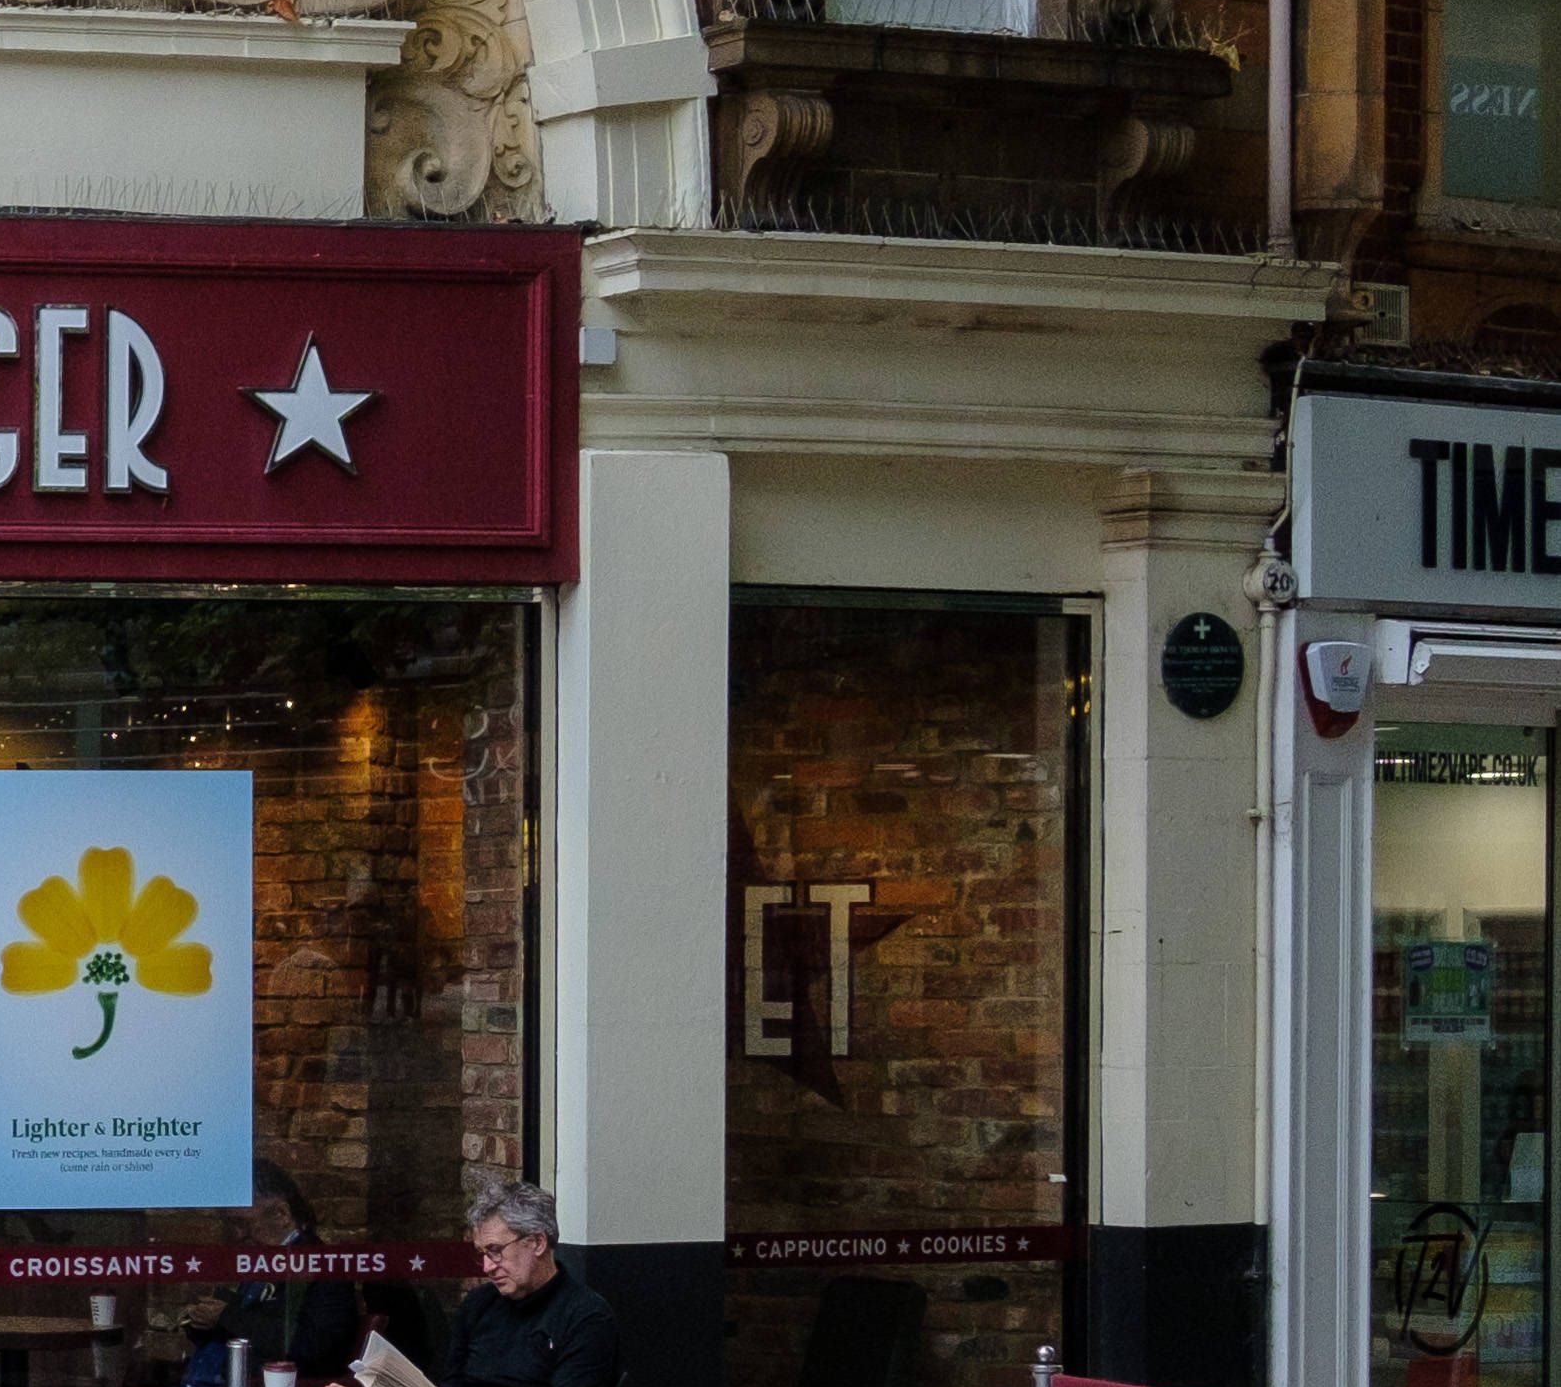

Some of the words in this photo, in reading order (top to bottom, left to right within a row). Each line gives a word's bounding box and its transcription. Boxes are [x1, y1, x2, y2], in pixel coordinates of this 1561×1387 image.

[12, 1117, 90, 1143] Lighter
[95, 1122, 106, 1136] &
[112, 1117, 202, 1142] Brighter
[12, 1149, 38, 1159] Fresh
[40, 1150, 59, 1158] new
[101, 1149, 153, 1158] handmade
[155, 1149, 180, 1159] every
[756, 1237, 887, 1259] CAPPUCCINO
[920, 1235, 1006, 1255] COOKIES
[9, 1255, 174, 1277] CROISSANTS
[236, 1253, 386, 1273] BAGUETTES
